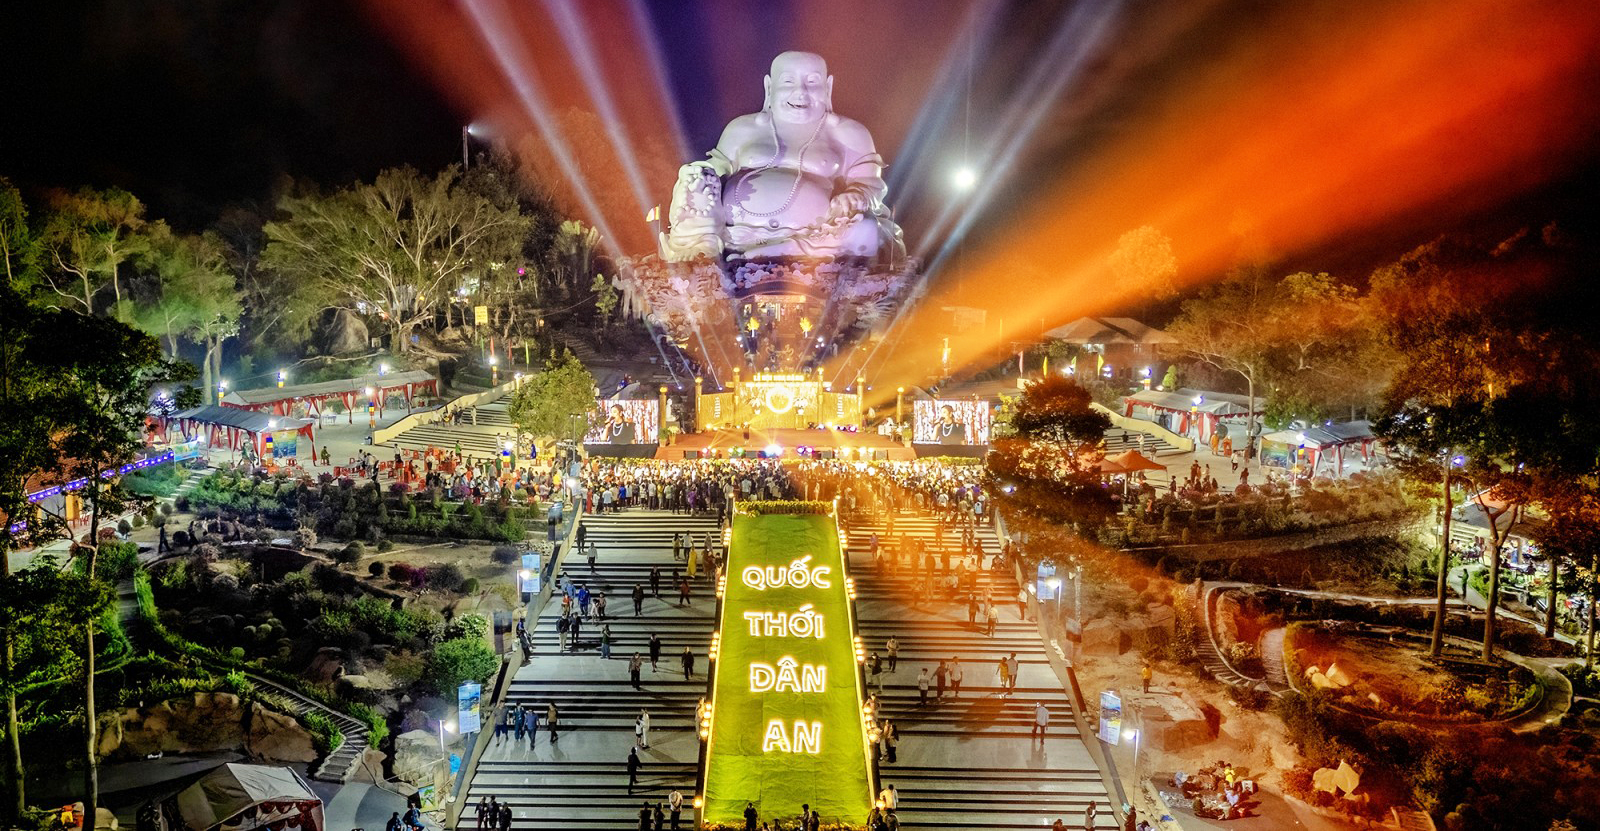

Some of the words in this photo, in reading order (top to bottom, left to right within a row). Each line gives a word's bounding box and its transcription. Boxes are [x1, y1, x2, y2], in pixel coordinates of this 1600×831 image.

[742, 555, 831, 591] QUỐC
[743, 603, 825, 639] THỚI
[762, 719, 821, 754] AN
